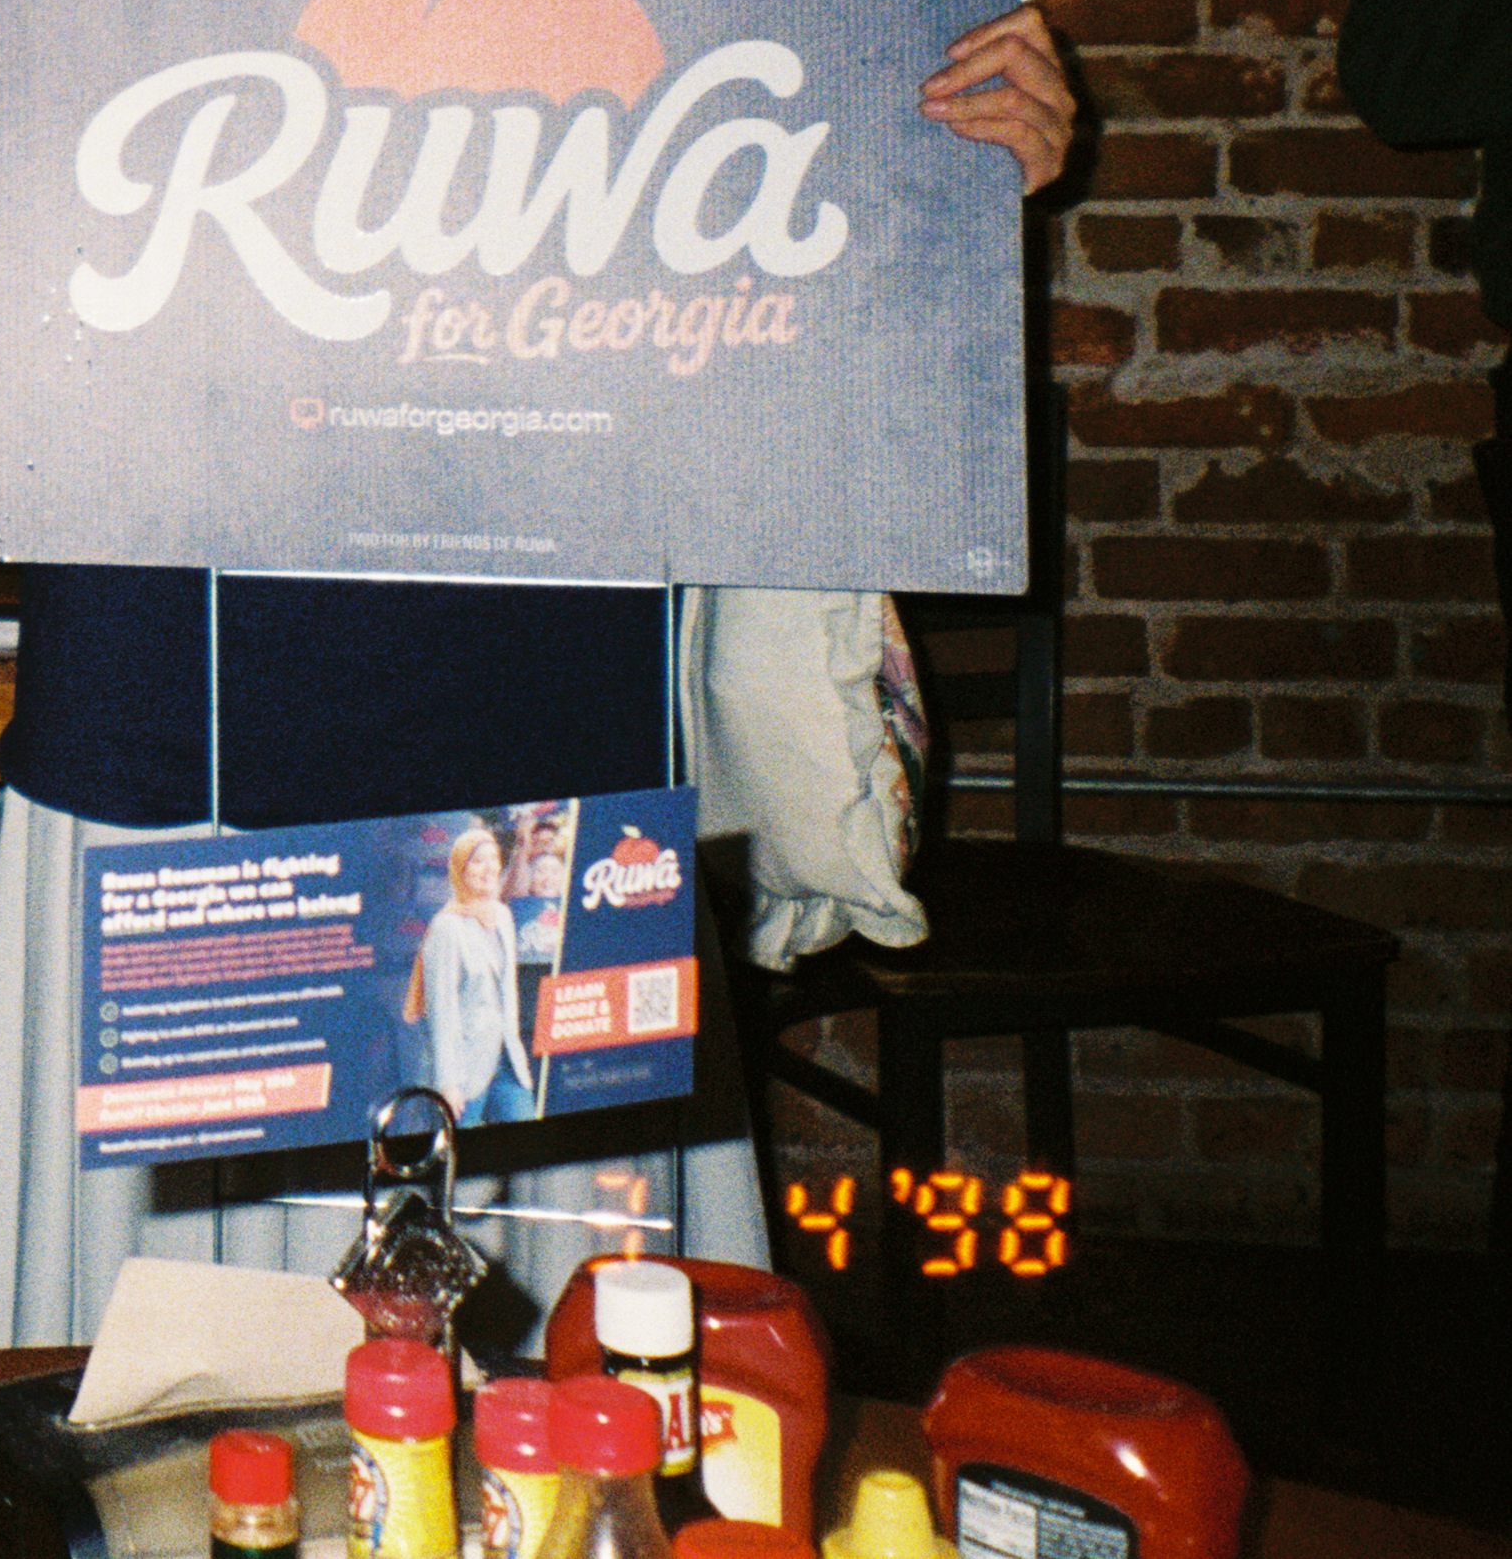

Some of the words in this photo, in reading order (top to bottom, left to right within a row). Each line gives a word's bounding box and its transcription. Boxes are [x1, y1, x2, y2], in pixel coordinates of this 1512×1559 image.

[67, 40, 848, 341] Ruwa
[397, 287, 497, 365] for
[505, 276, 798, 376] Georgia
[329, 402, 614, 437] ruwaforgeorgia.com
[582, 848, 683, 911] Ruwa
